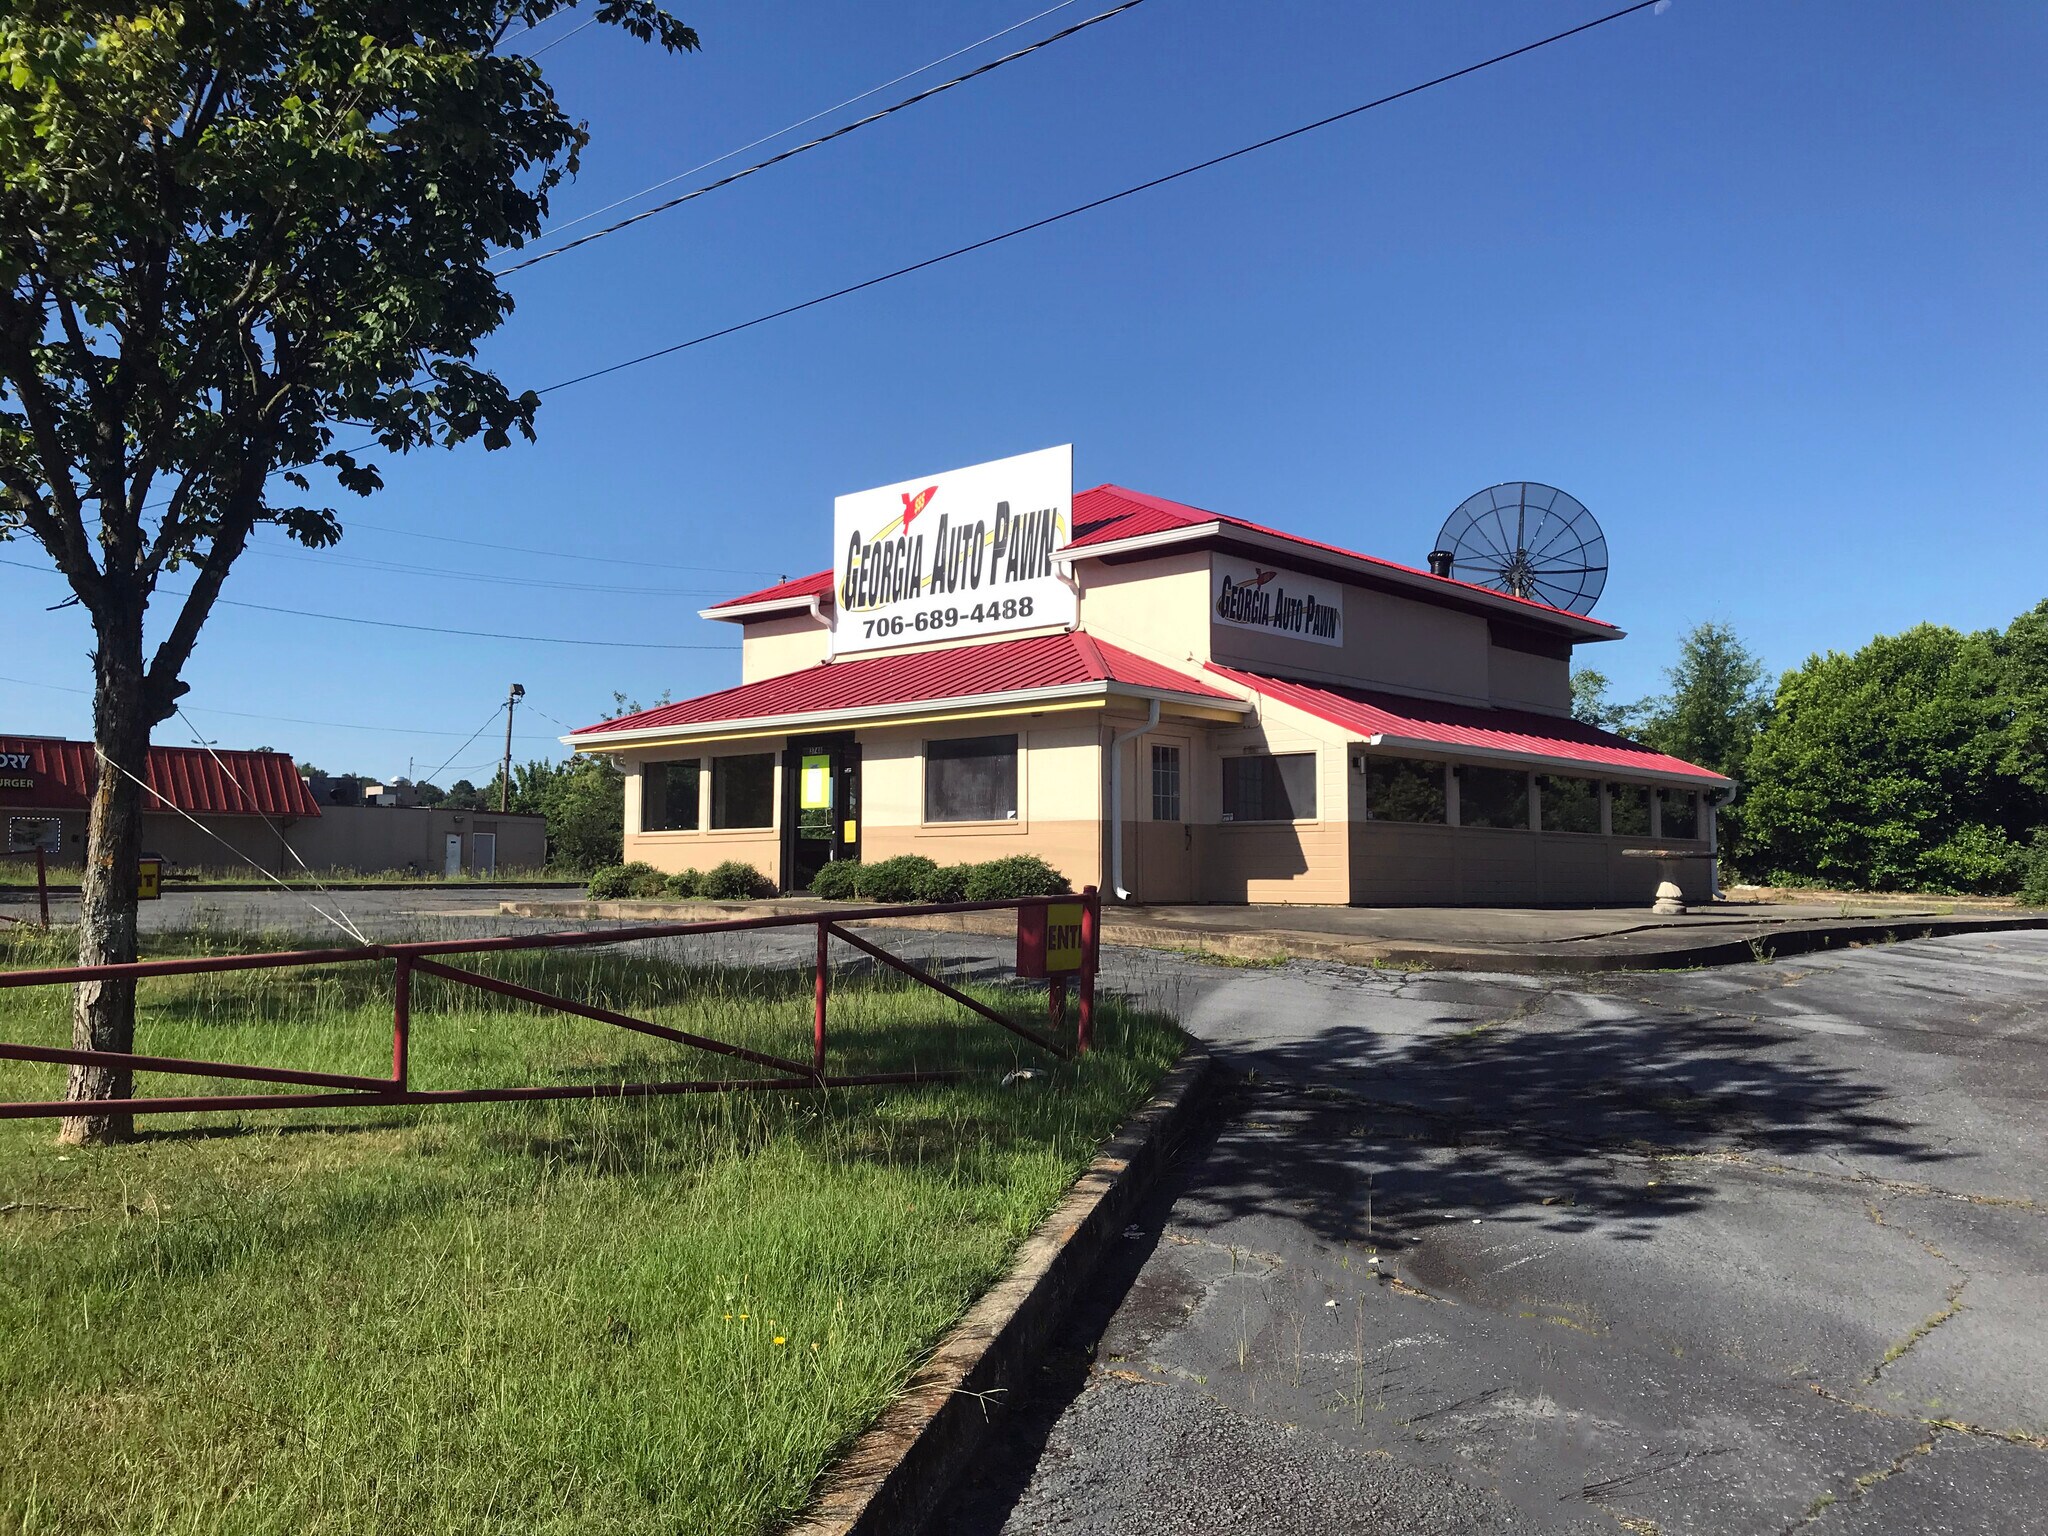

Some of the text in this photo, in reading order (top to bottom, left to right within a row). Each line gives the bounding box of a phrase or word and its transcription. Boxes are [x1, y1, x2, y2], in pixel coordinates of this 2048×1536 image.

[863, 596, 1034, 639] 706-689-4488
[0, 754, 30, 769] ORY
[1048, 924, 1082, 950] ENT
